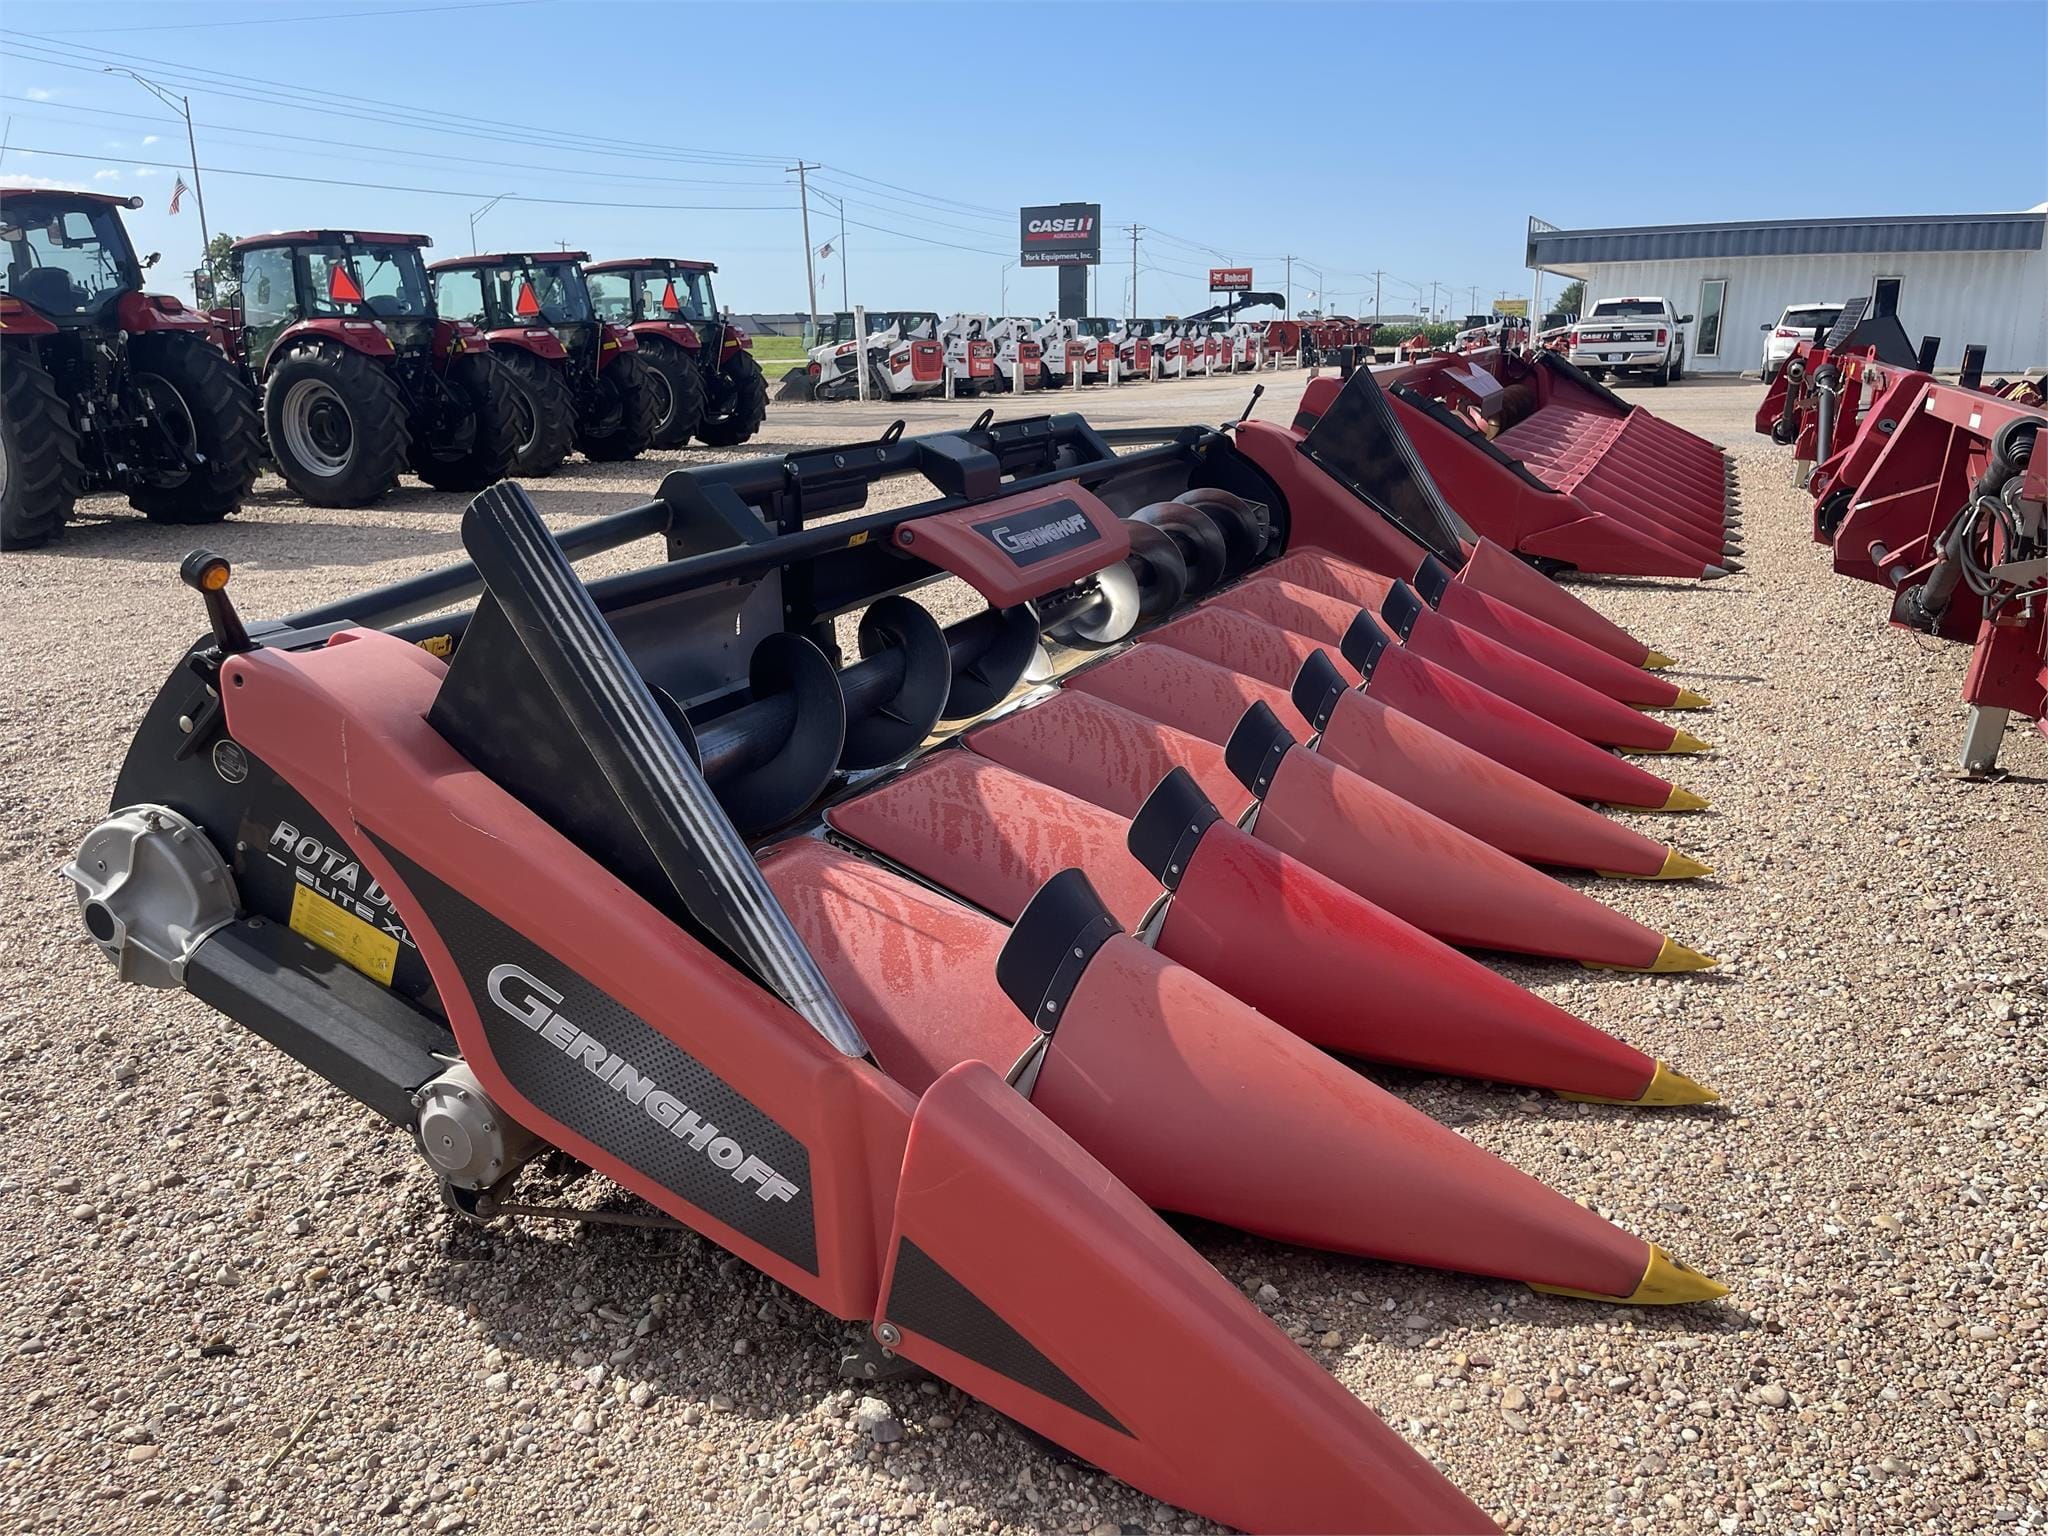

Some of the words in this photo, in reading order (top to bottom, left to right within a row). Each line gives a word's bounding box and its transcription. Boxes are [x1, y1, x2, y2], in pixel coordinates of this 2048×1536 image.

[1028, 218, 1076, 233] CASE
[1041, 253, 1079, 262] Equipment,
[1080, 251, 1093, 259] Inc.
[1224, 273, 1249, 283] Bobcat
[991, 513, 1088, 554] GERINGHOFF
[270, 820, 360, 892] ROTA
[295, 865, 375, 923] ELITE
[381, 917, 417, 949] XL
[487, 963, 800, 1202] GERINGHOFF
